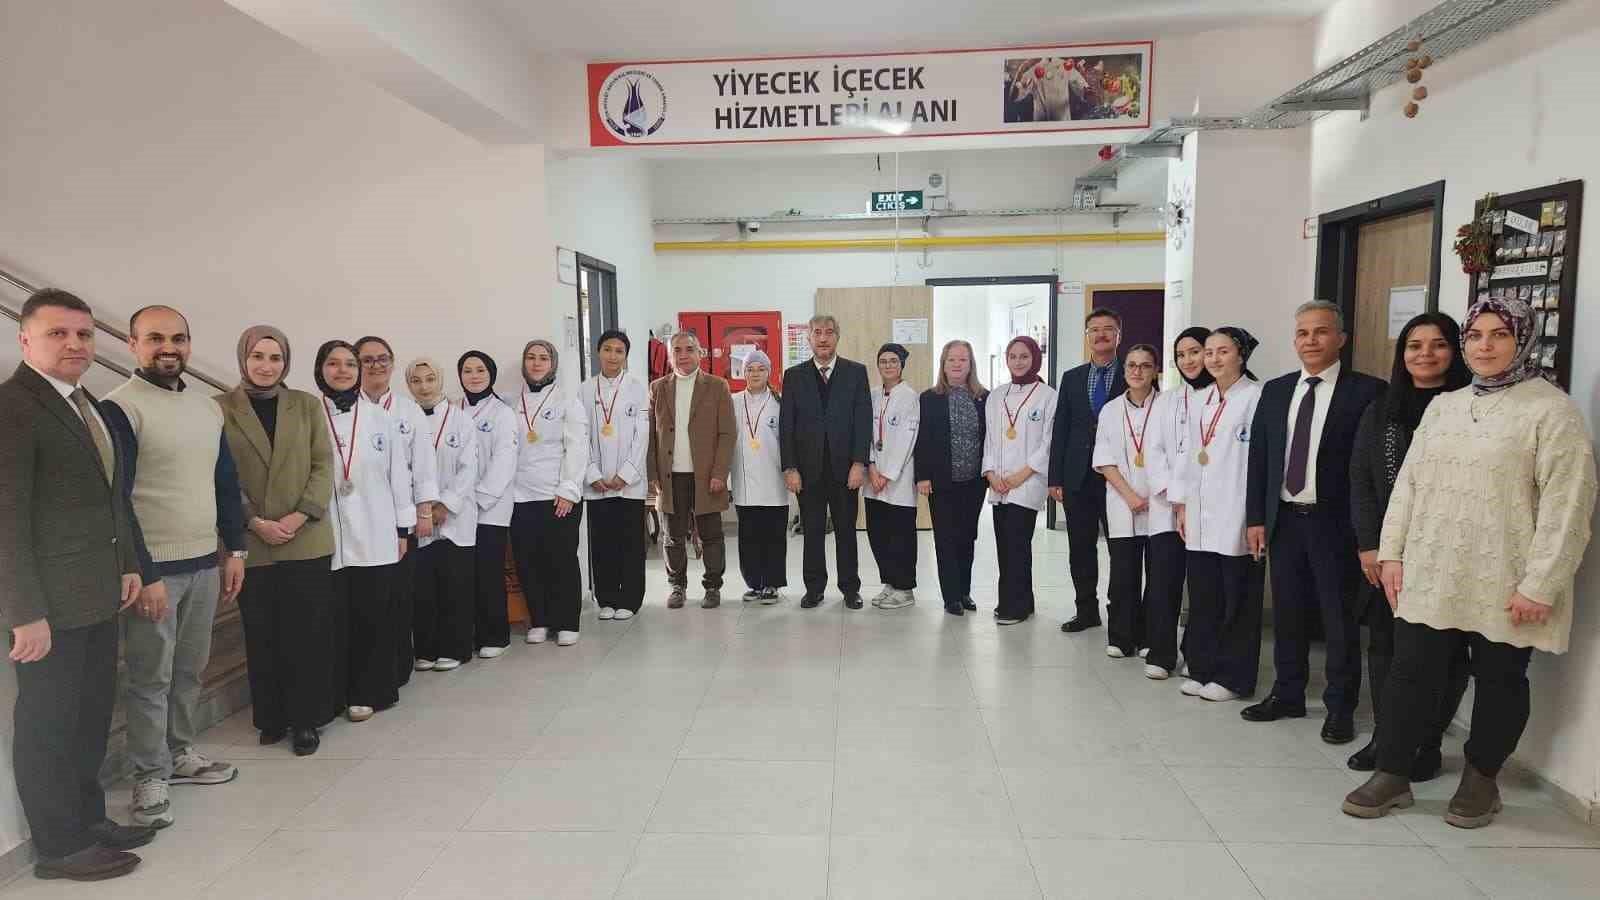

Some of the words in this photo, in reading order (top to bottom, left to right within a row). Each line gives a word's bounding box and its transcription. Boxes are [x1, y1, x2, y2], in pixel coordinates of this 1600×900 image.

[713, 68, 820, 96] YİYECEK
[833, 64, 925, 98] İÇECEK
[878, 193, 904, 202] EXIT
